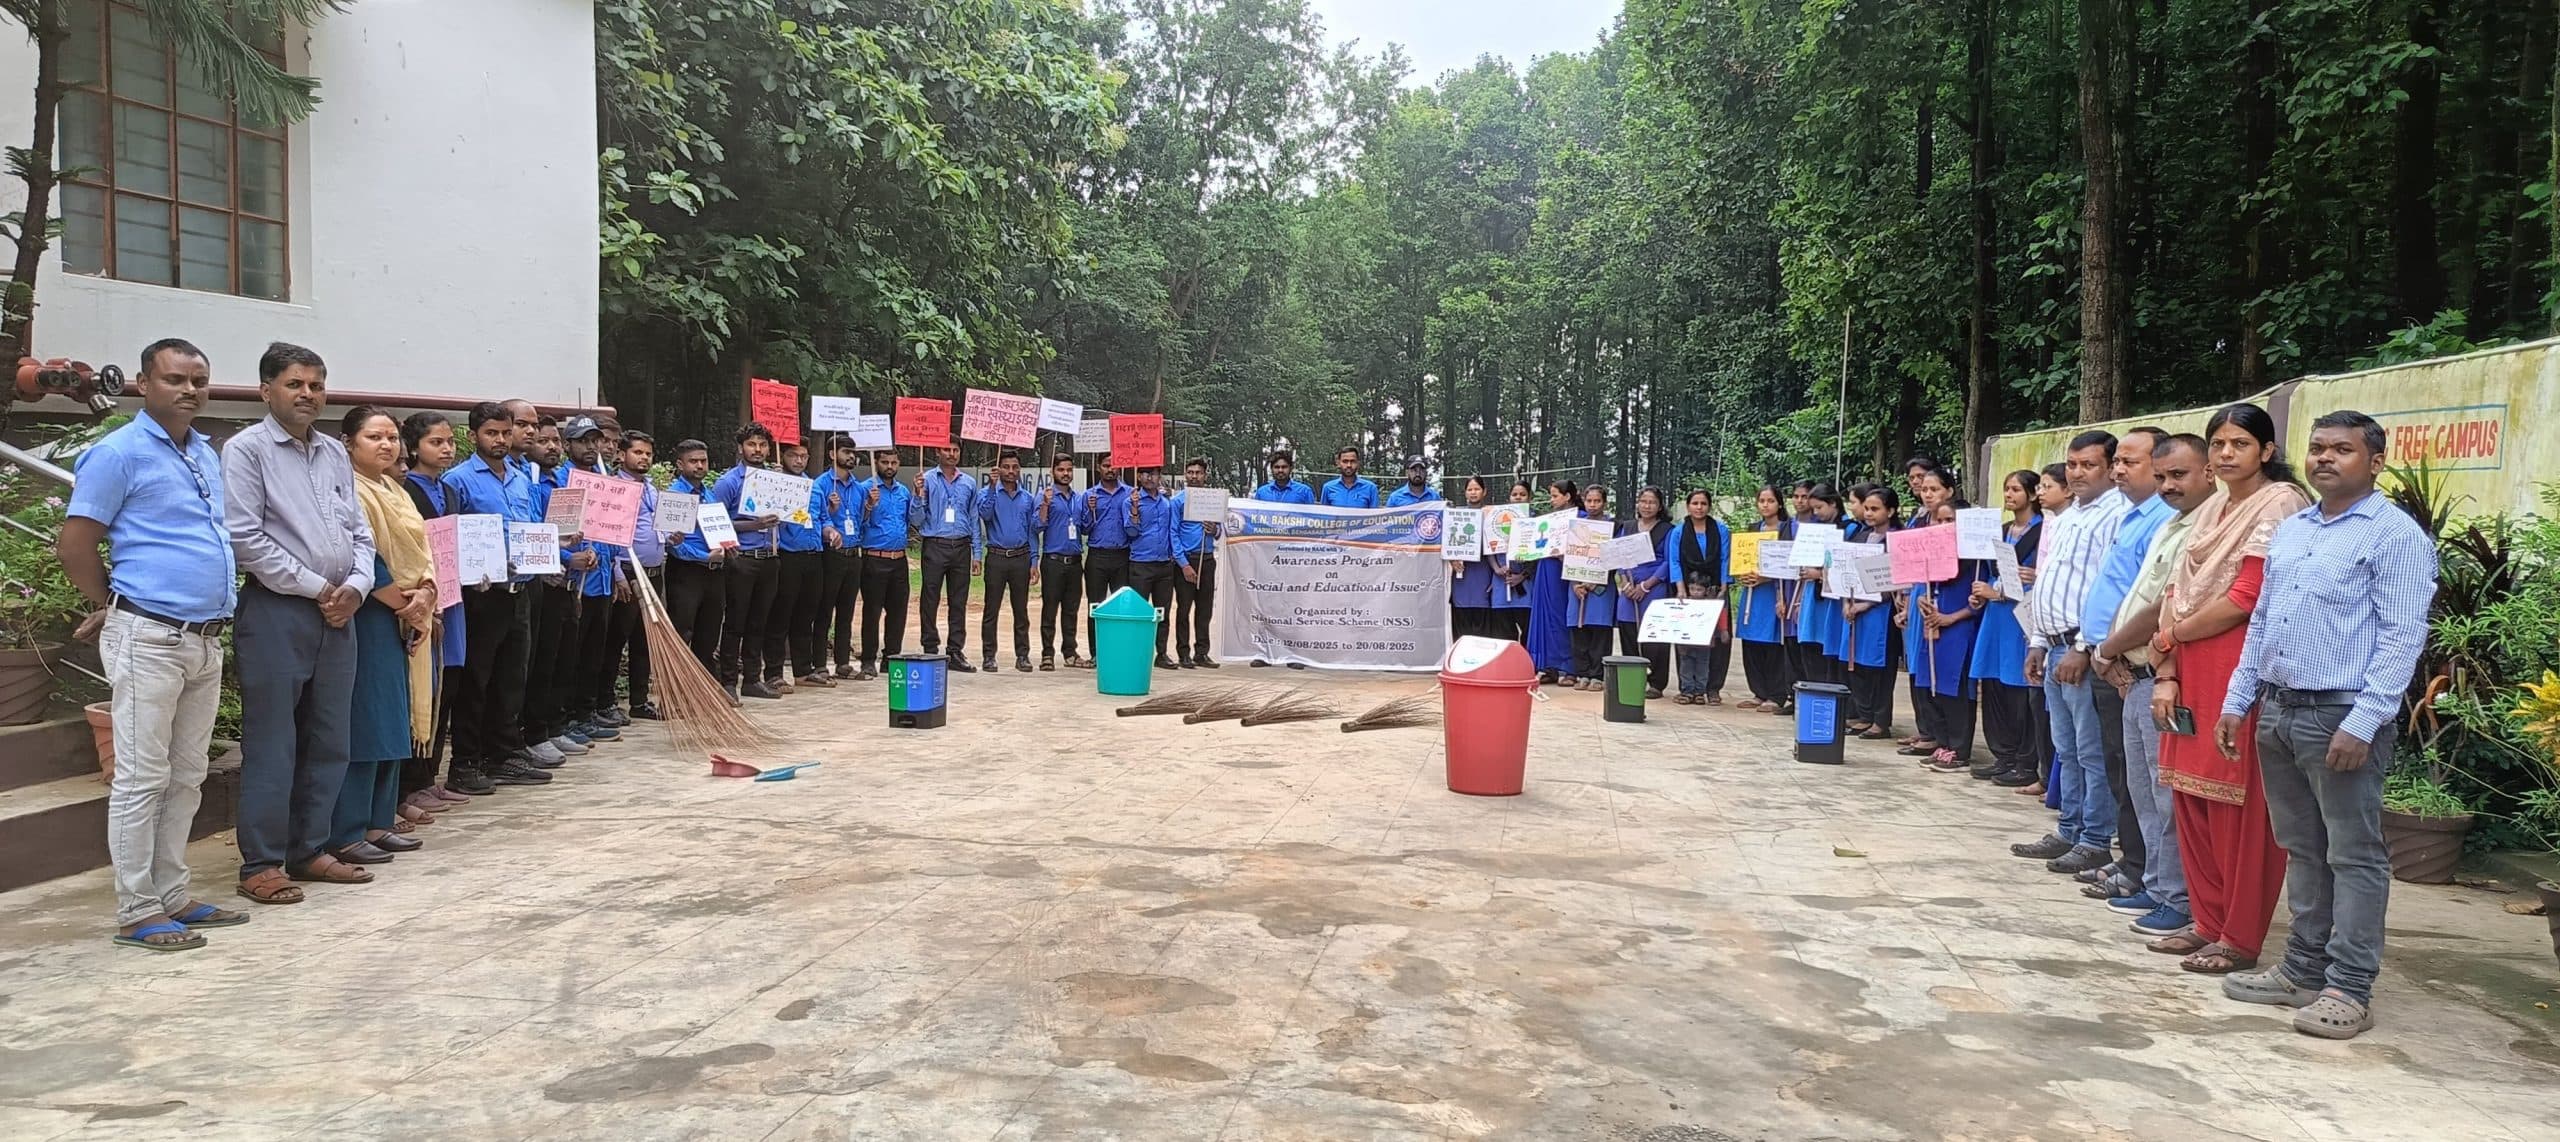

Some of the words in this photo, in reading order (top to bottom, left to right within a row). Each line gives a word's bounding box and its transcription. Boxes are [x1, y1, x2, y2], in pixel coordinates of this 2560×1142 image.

[2394, 424, 2431, 461] FREE
[2435, 420, 2498, 458] CAMPUS
[1272, 515, 1305, 526] BAKSHI
[1307, 518, 1348, 529] COLLEGE
[1350, 519, 1360, 527] OF
[1363, 515, 1415, 526] EDUCATION
[1271, 555, 1337, 566] Awareness
[1341, 555, 1393, 567] Program
[1325, 571, 1338, 579] on
[1287, 583, 1310, 592] and
[1313, 582, 1385, 592] Educational
[1294, 607, 1347, 617] Organized
[1351, 608, 1363, 617] by
[1296, 617, 1334, 626] Service
[1338, 617, 1379, 626] Scheme
[1383, 617, 1414, 626] (NSS)
[1283, 640, 1338, 649] 12/08/2025
[1356, 641, 1415, 651] 20/08/2025
